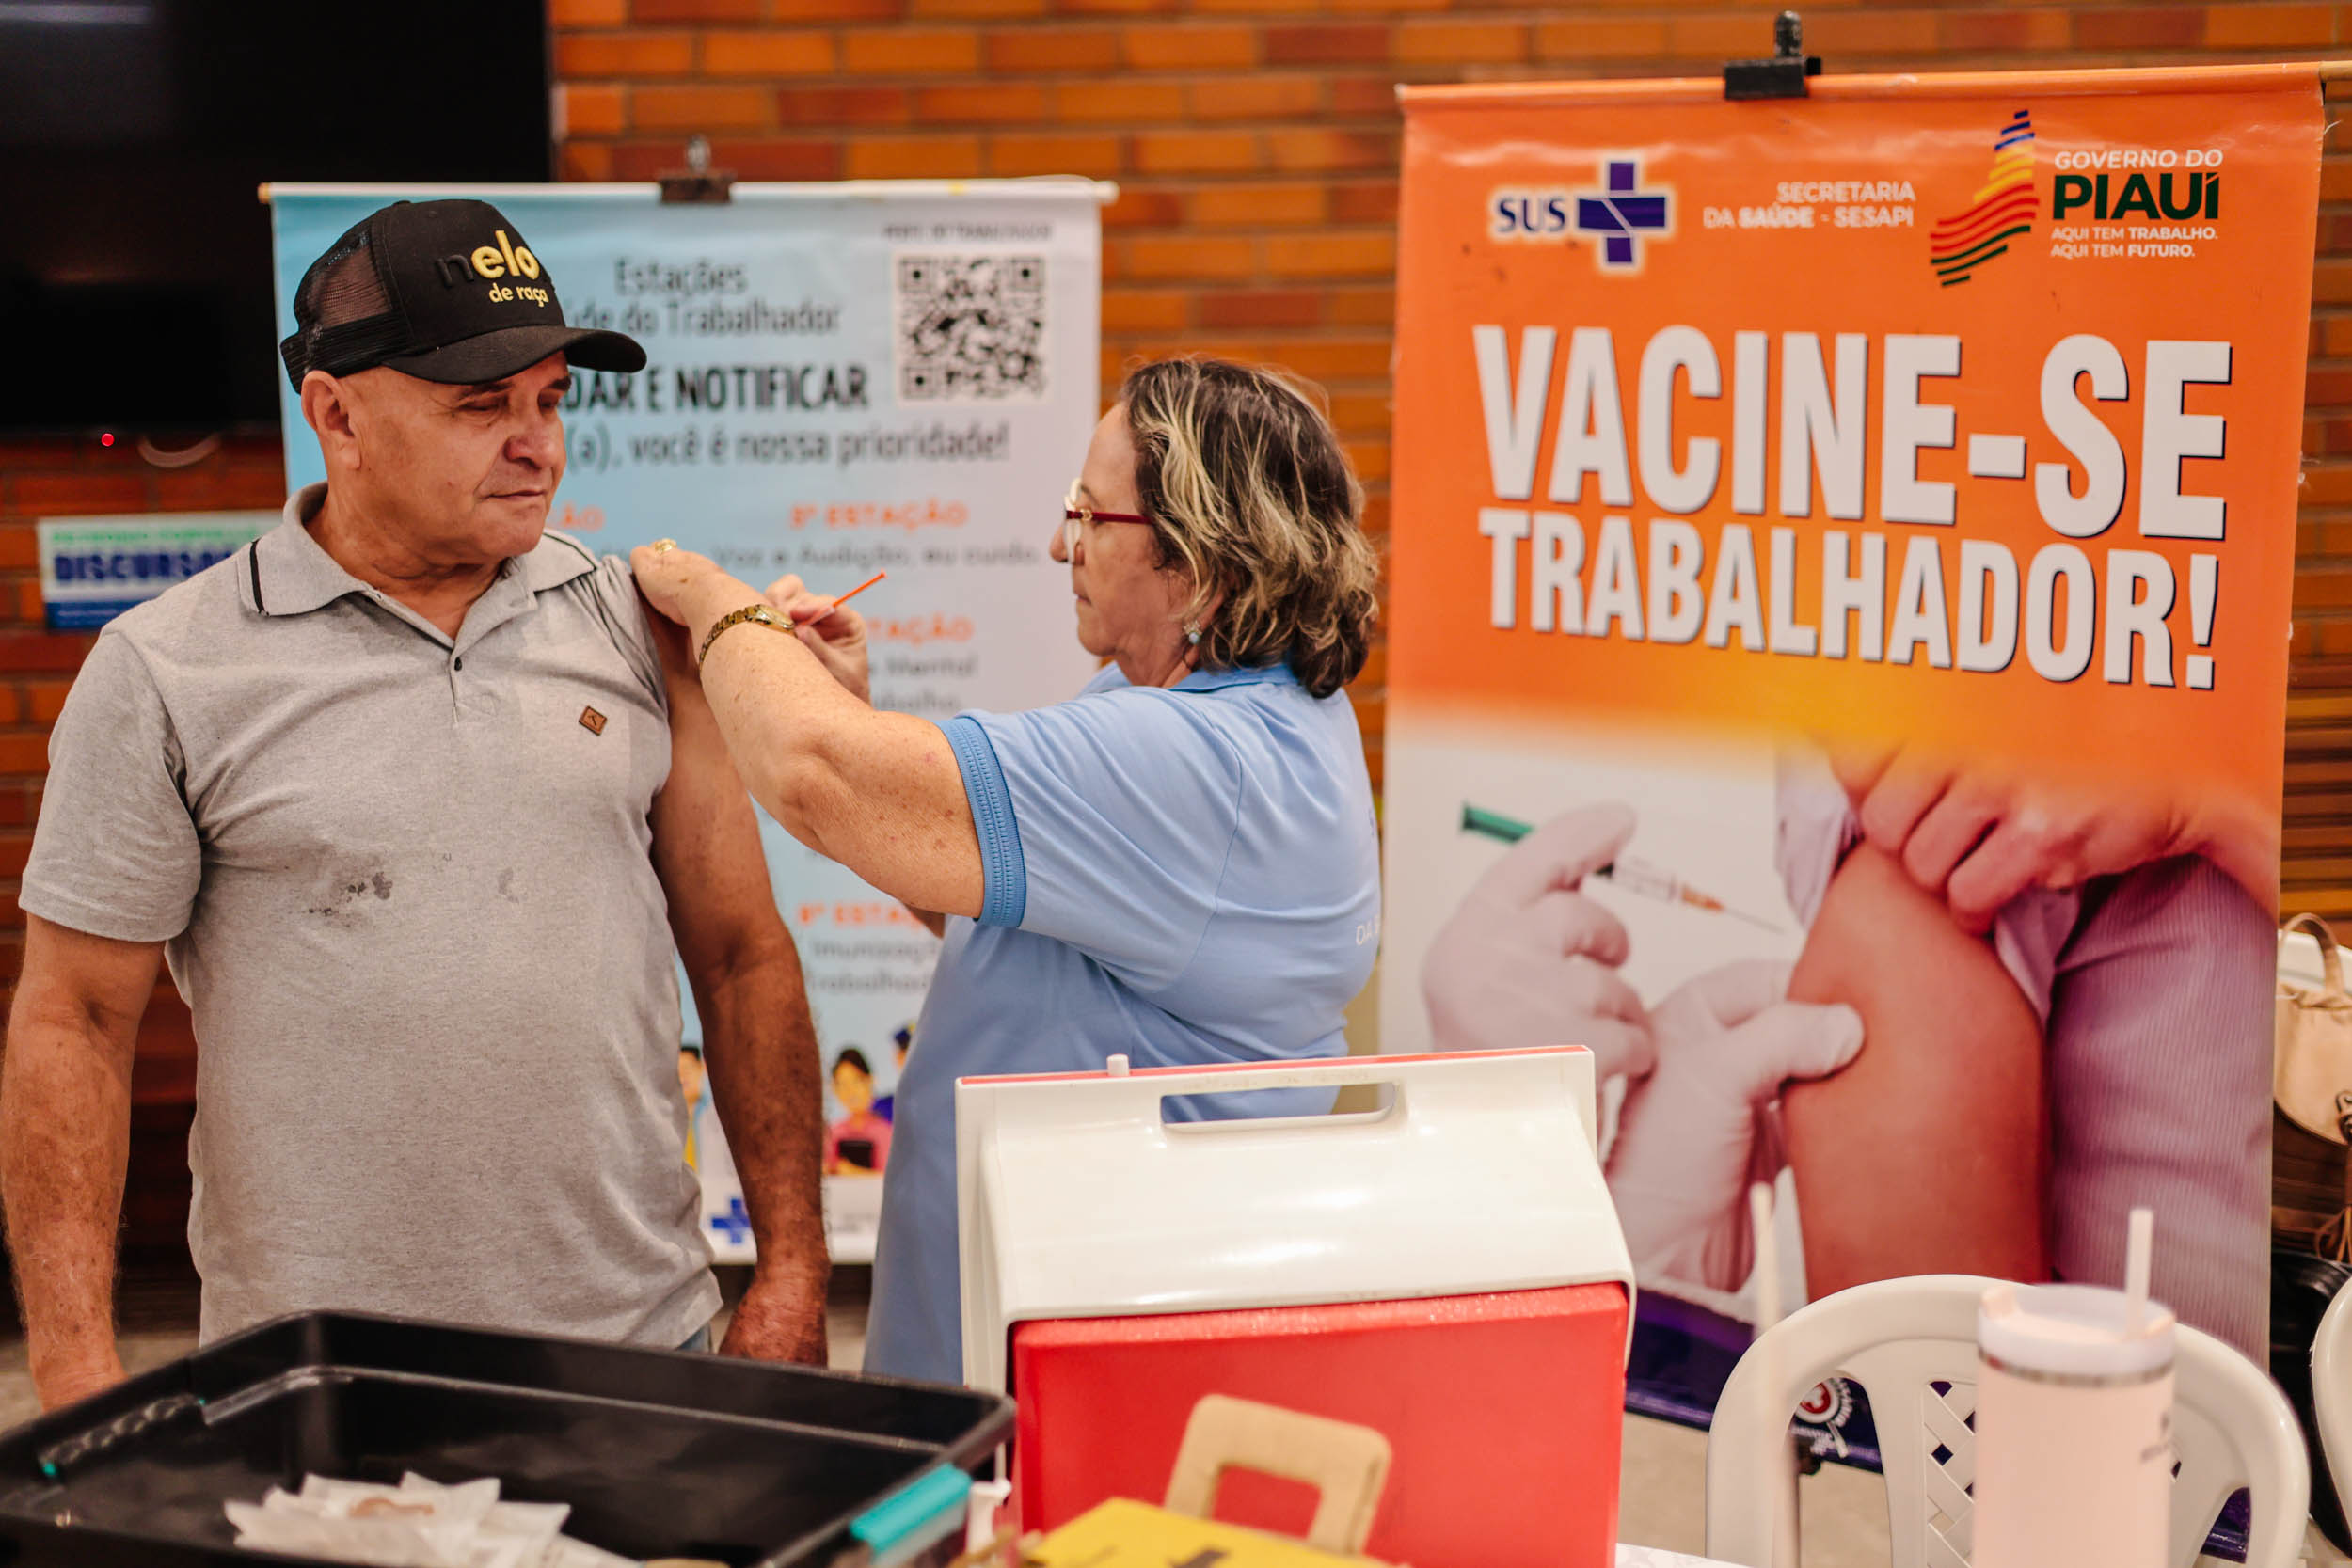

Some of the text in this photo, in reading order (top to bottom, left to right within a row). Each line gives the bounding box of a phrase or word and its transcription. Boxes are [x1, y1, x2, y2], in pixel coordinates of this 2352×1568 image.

[2055, 149, 2224, 169] GOVERNO DO
[1777, 181, 1916, 204] SECRETARIA
[2053, 172, 2219, 220] PIAUÍ
[1497, 197, 1566, 232] SUS
[1704, 207, 1735, 229] DA
[1739, 202, 1815, 229] SAÚDE
[1834, 206, 1914, 228] SESAPI
[2051, 226, 2218, 242] AQUI TEM TRABALHO.
[2051, 244, 2195, 260] AQUI TEM FUTURO.
[488, 282, 549, 308] de raça
[616, 257, 746, 298] Estações
[621, 301, 659, 333] do
[666, 296, 839, 334] Trabalhador
[561, 365, 869, 411] DAR E NOTIFICAR
[630, 429, 698, 463] você
[715, 425, 731, 463] é
[737, 433, 829, 463] nossa
[839, 419, 1009, 470] prioridade!
[1473, 325, 2231, 540] VACINE-SE
[827, 496, 969, 538] ESTAÇÃO
[1478, 507, 2218, 691] TRABALHADOR!
